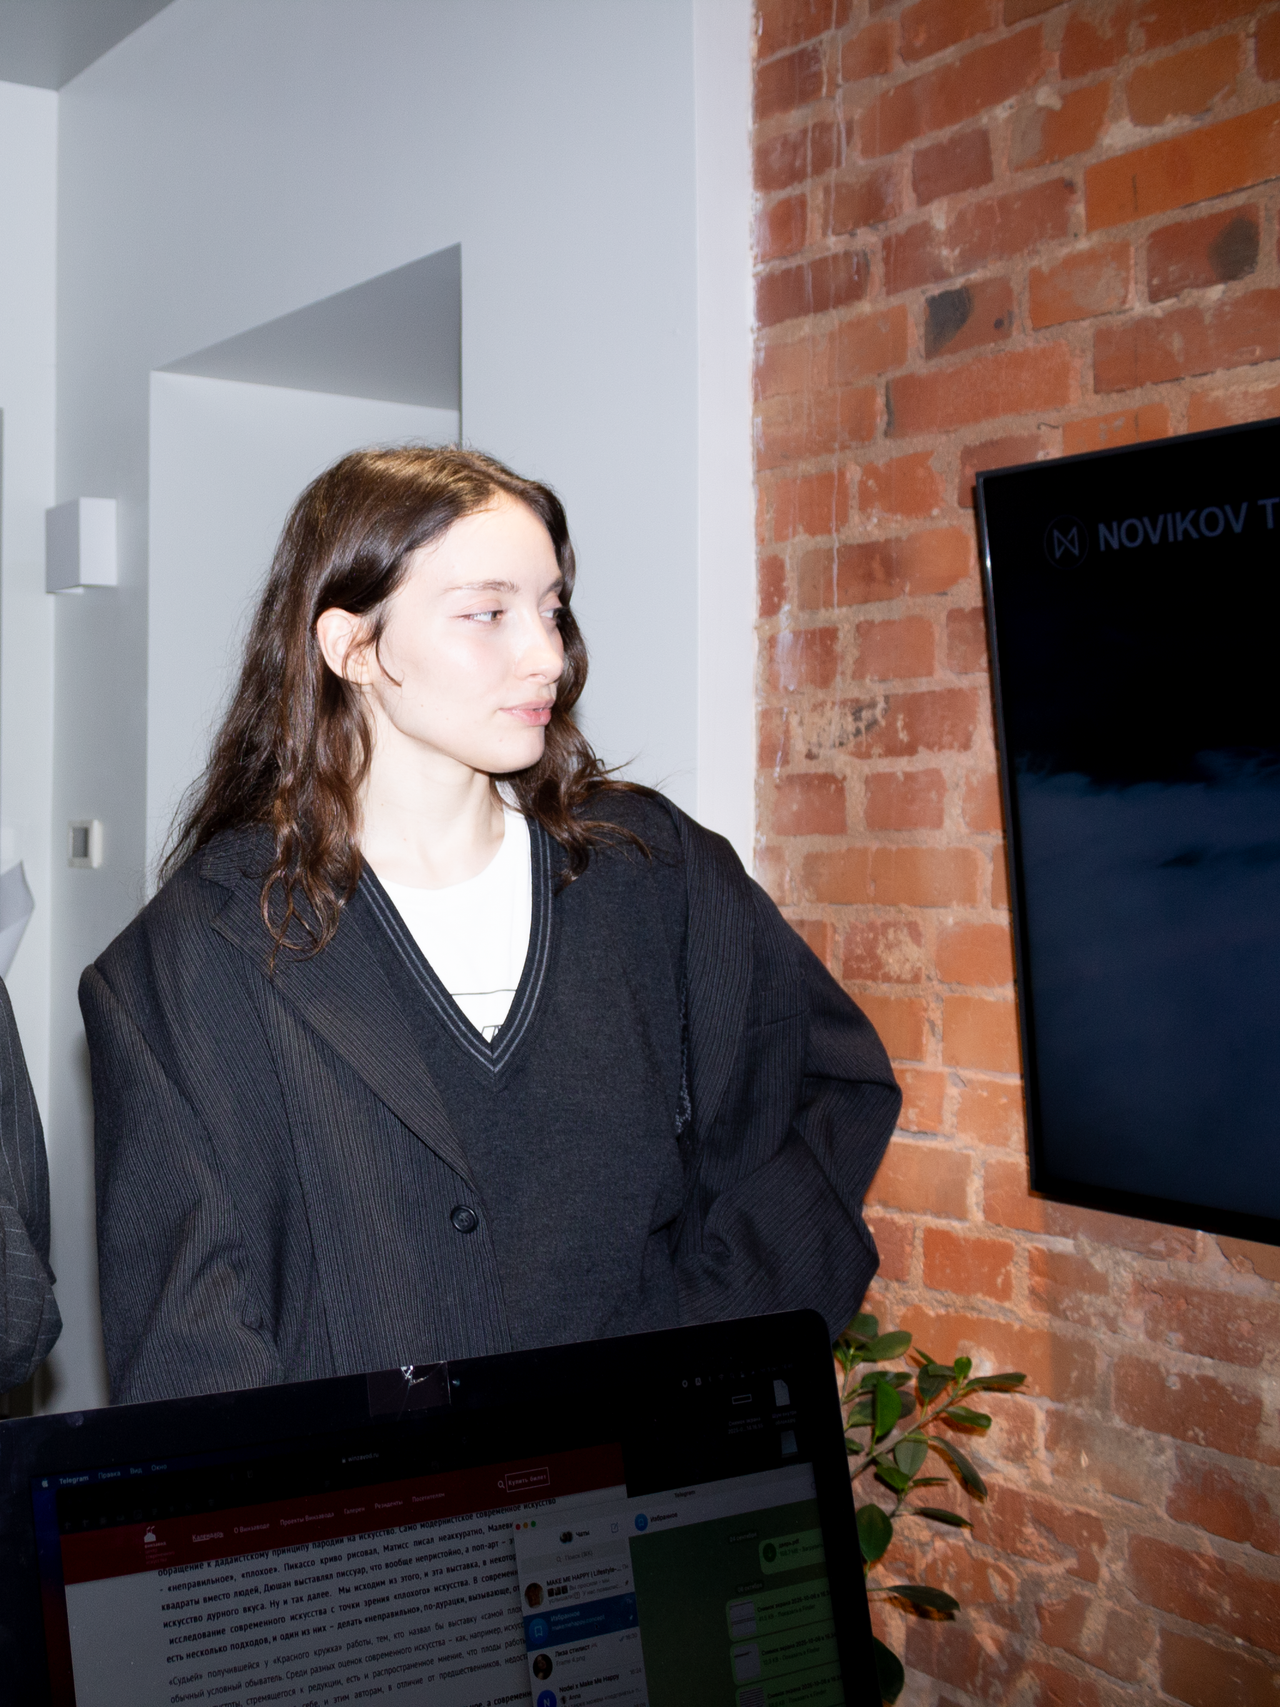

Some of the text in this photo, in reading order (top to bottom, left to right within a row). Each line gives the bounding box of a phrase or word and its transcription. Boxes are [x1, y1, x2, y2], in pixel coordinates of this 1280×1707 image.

[1098, 497, 1280, 551] NOVIKOV T
[58, 1463, 168, 1485] Telegram Правка Вид Окно
[347, 1452, 379, 1462] winzavod.ru
[507, 1474, 547, 1486] Купить билет
[157, 1497, 556, 1576] обращение к дадаистскому принципу пародии на искусство. Само модернистское современное искусство
[233, 1526, 239, 1534] О
[238, 1522, 270, 1533] Винзаводе
[279, 1517, 305, 1527] Проекты
[304, 1511, 335, 1522] Винзавода
[343, 1506, 365, 1515] Галереи
[373, 1500, 403, 1509] Резиденты
[411, 1492, 445, 1503] Посетителям
[161, 1540, 499, 1611] квадраты вместо людей, Дюшан выставлял писсуар, что вообще непристойно, а поп-арт
[167, 1574, 236, 1592] «неправильное»,
[240, 1566, 280, 1578] «плохое».
[283, 1559, 316, 1571] Пикассо
[319, 1554, 343, 1565] криво
[346, 1547, 380, 1561] рисовал,
[382, 1541, 409, 1552] Матисс
[413, 1536, 435, 1547] писал
[438, 1527, 485, 1542] неаккуратно,
[546, 1571, 590, 1586] MAKE ME HAPPY
[162, 1614, 203, 1628] искусство
[206, 1608, 239, 1622] дурного
[242, 1603, 267, 1614] вкуса.
[269, 1599, 280, 1609] Ну
[291, 1595, 304, 1604] так
[306, 1590, 332, 1602] далее.
[337, 1586, 351, 1594] Мы
[353, 1579, 386, 1591] исходим
[388, 1577, 398, 1585] из
[400, 1572, 422, 1583] этого,
[431, 1568, 444, 1577] эта
[445, 1561, 480, 1573] выставка,
[168, 1628, 226, 1644] исследование
[229, 1616, 286, 1633] современного
[289, 1608, 327, 1621] искусства
[330, 1606, 335, 1614] с
[338, 1601, 360, 1611] точки
[364, 1595, 390, 1607] зрения
[393, 1587, 430, 1600] «плохого»
[433, 1579, 471, 1592] искусства.
[472, 1575, 478, 1585] В
[550, 1610, 580, 1622] Избранное
[166, 1654, 184, 1663] есть
[185, 1645, 228, 1659] несколько
[229, 1636, 271, 1650] подходов,
[279, 1631, 299, 1641] один
[300, 1628, 310, 1636] из
[312, 1625, 327, 1634] них
[336, 1618, 363, 1630] делать
[364, 1606, 422, 1622] «неправильно»,
[423, 1597, 467, 1611] по-дурацки,
[468, 1587, 512, 1602] вызывающе,
[168, 1672, 203, 1686] «Судьей»
[207, 1661, 260, 1678] получившейся
[263, 1659, 269, 1669] у
[272, 1651, 310, 1665] «Красного
[313, 1644, 342, 1657] кружка»
[345, 1638, 373, 1651] работы,
[375, 1634, 391, 1643] тем,
[393, 1630, 405, 1639] кто
[408, 1625, 431, 1636] назвал
[434, 1622, 444, 1631] бы
[447, 1616, 477, 1628] выставку
[480, 1608, 504, 1620] «самой
[554, 1644, 590, 1657] Лиза стилист
[170, 1689, 205, 1704] обычный
[206, 1681, 242, 1698] условный
[244, 1674, 285, 1688] обыватель.
[285, 1669, 308, 1680] Среди
[309, 1663, 335, 1676] разных
[337, 1657, 363, 1668] оценок
[364, 1646, 412, 1662] современного
[413, 1638, 446, 1651] искусства
[454, 1634, 468, 1642] как,
[469, 1626, 503, 1639] например,
[245, 1688, 296, 1706] стремящегося
[307, 1679, 343, 1694] редукции,
[345, 1674, 361, 1684] есть
[363, 1672, 369, 1680] и
[372, 1658, 434, 1679] распространенное
[437, 1651, 464, 1663] мнение,
[466, 1648, 478, 1656] что
[480, 1643, 501, 1653] плоды
[323, 1698, 329, 1706] и
[333, 1694, 350, 1704] этим
[354, 1686, 385, 1699] авторам,
[387, 1684, 393, 1692] в
[396, 1677, 423, 1689] отличие
[427, 1674, 435, 1683] от
[439, 1660, 501, 1680] предшественников,
[579, 1680, 594, 1688] Make
[602, 1674, 620, 1682] Happy
